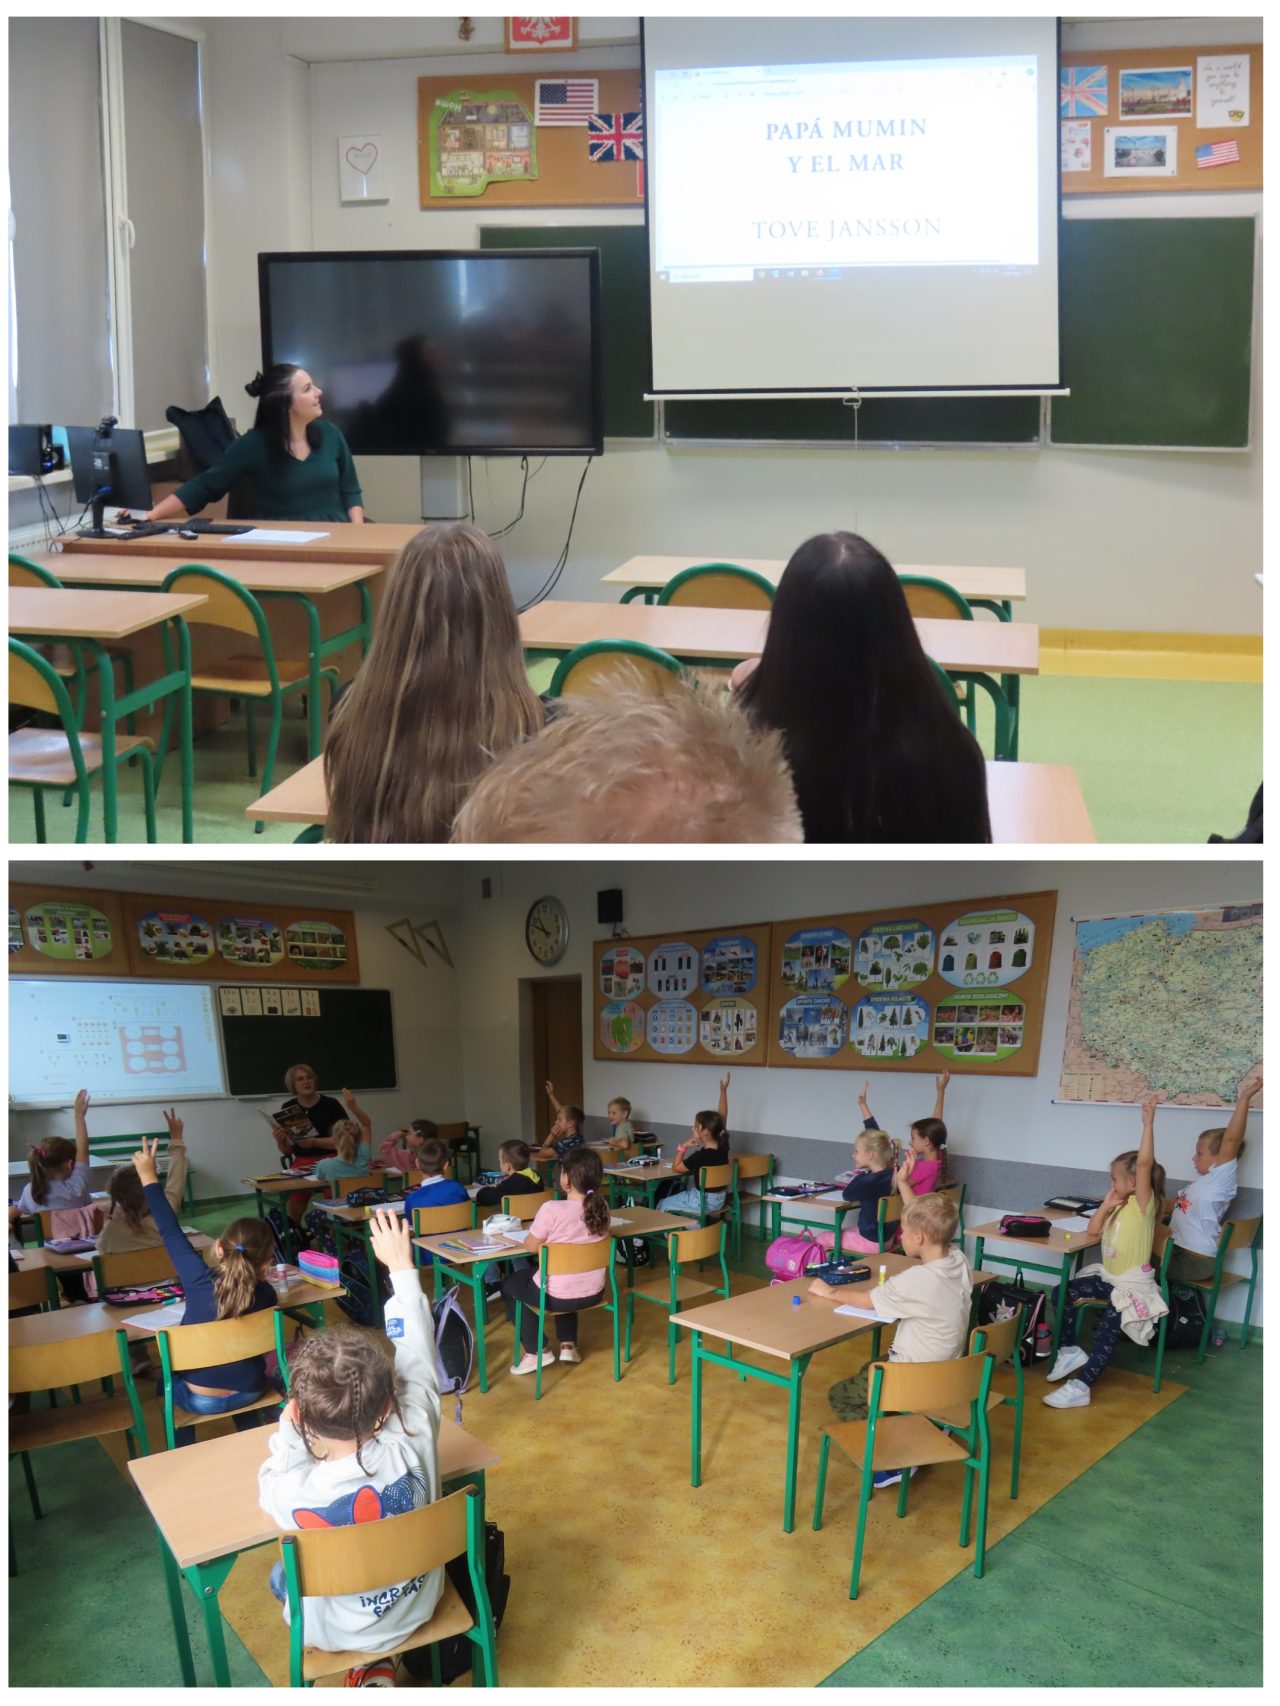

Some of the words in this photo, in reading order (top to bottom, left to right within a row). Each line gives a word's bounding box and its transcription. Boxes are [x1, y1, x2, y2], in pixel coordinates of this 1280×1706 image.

[435, 98, 462, 113] Home
[765, 117, 824, 141] PAPÁ
[832, 118, 927, 139] MUMIN
[787, 156, 803, 173] Y
[811, 155, 840, 172] EL
[849, 153, 905, 172] MAR
[751, 219, 820, 240] TOVE
[826, 217, 942, 242] JANSSON
